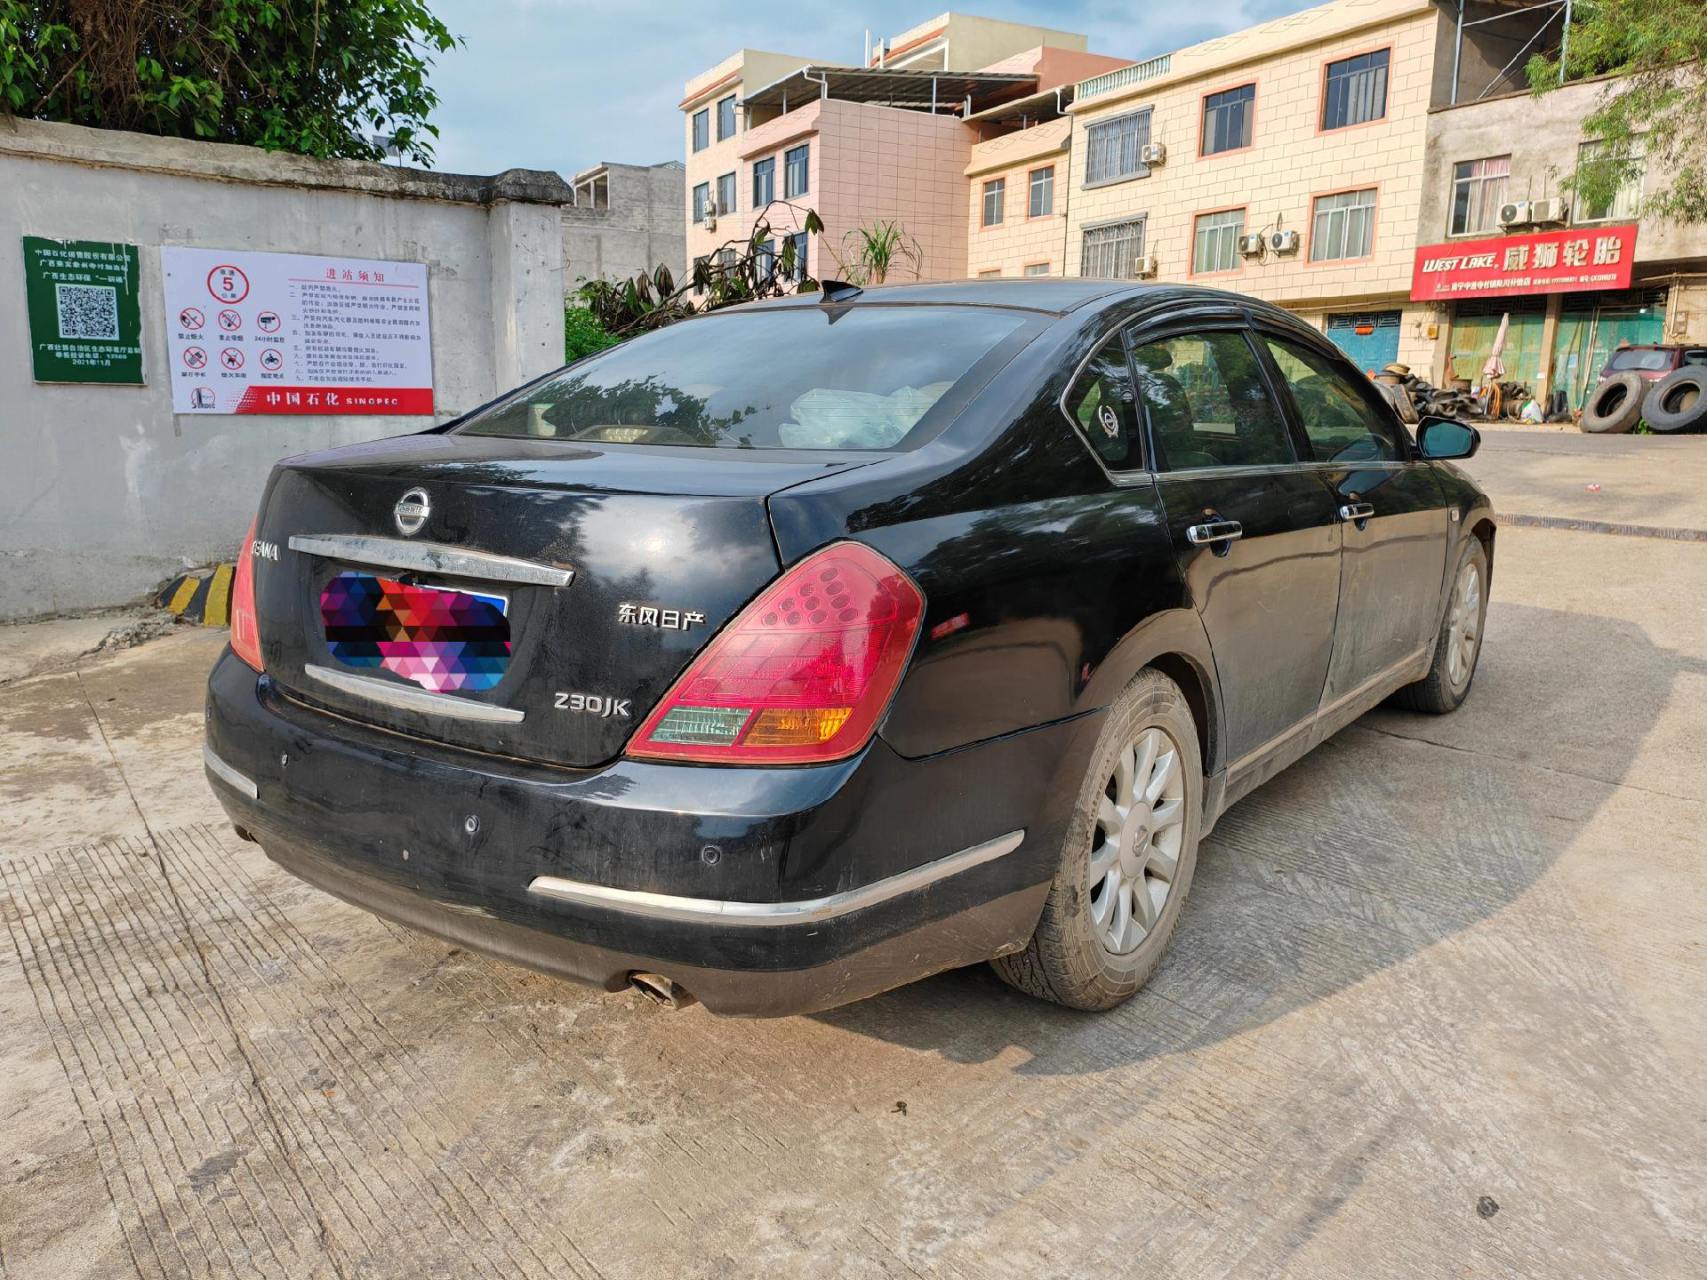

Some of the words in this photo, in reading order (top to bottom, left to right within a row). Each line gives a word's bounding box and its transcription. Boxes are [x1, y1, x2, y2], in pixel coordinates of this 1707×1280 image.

[1422, 258, 1459, 273] WEST
[1459, 253, 1497, 270] LAKE
[1502, 236, 1622, 272] 威狮轮胎
[223, 276, 234, 291] 5
[325, 267, 385, 283] 进站须知
[266, 391, 341, 407] 中国石化
[346, 396, 399, 406] SINOPEC
[618, 603, 705, 631] 东风日产
